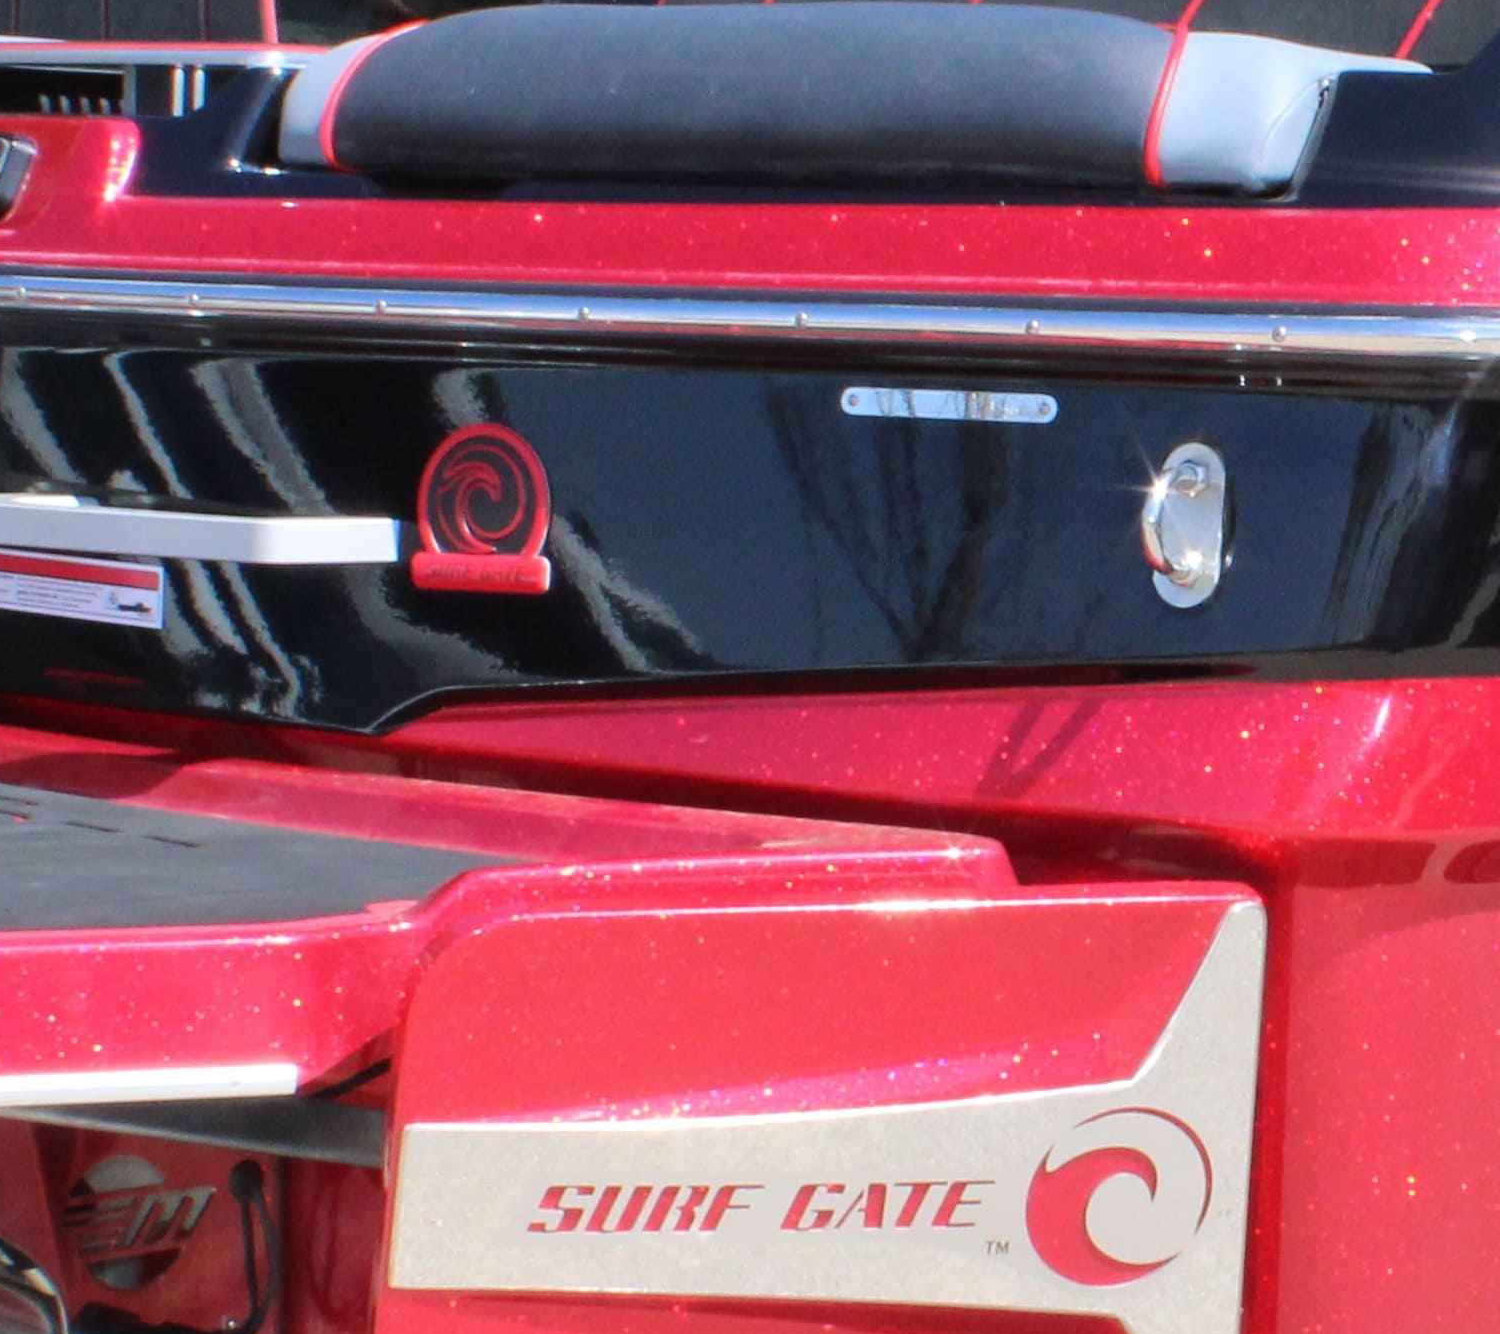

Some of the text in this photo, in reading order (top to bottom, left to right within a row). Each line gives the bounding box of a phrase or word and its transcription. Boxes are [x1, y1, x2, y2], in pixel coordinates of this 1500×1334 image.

[526, 1179, 997, 1234] SURF GATE
[985, 1240, 1010, 1256] TM
